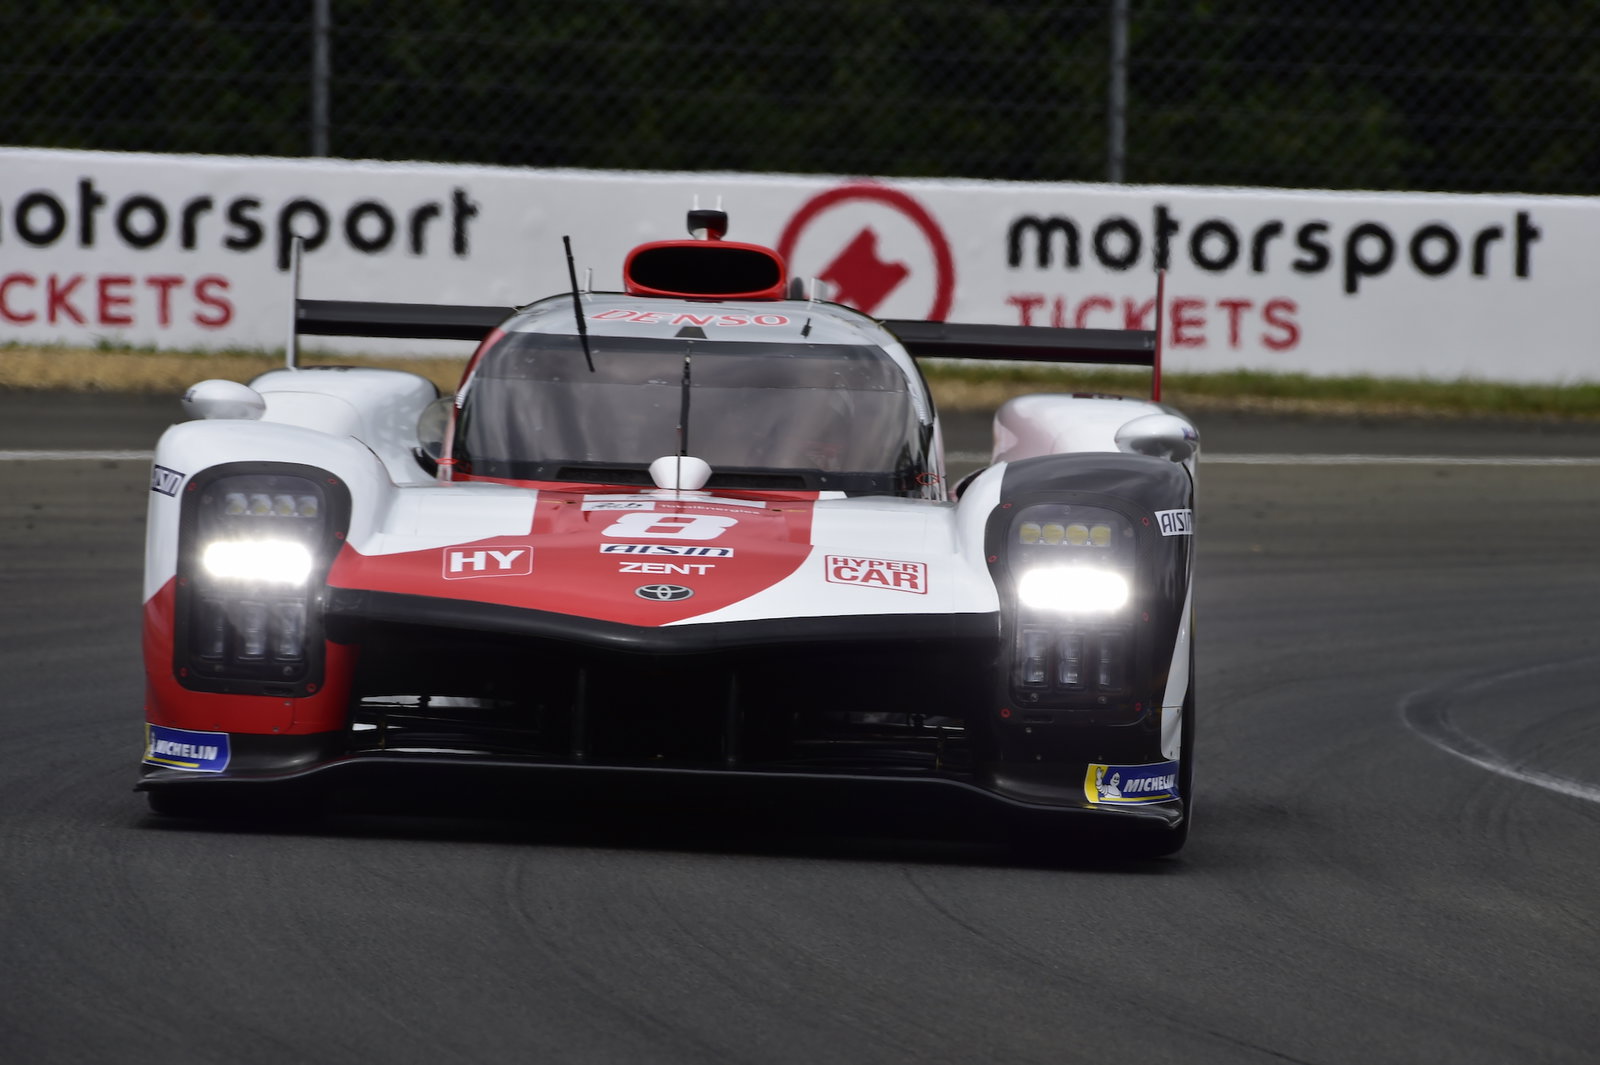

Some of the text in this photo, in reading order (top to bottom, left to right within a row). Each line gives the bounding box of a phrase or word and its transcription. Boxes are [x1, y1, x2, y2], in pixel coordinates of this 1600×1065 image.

[0, 177, 479, 271] otorsport
[1006, 204, 1543, 296] motorsport
[0, 272, 235, 329] CKETS
[590, 309, 790, 327] DENSO
[600, 512, 739, 541] 8
[449, 549, 526, 573] HY
[618, 561, 716, 576] ZENT
[832, 557, 918, 573] HYPER
[832, 565, 919, 590] CAR
[1123, 774, 1175, 792] MICHELIN
